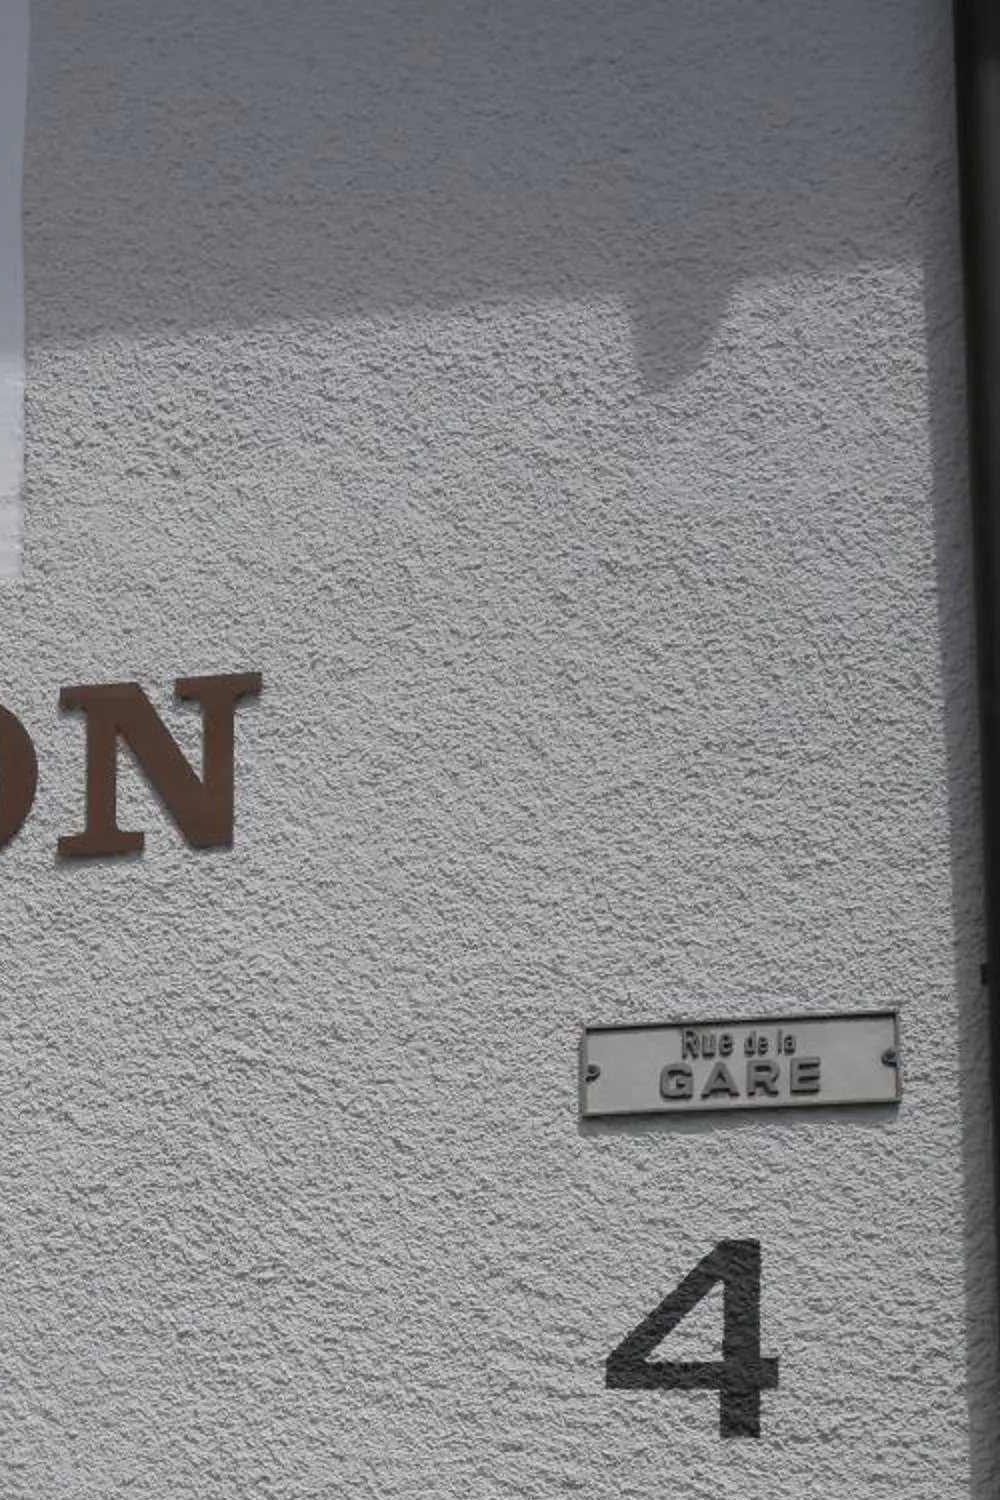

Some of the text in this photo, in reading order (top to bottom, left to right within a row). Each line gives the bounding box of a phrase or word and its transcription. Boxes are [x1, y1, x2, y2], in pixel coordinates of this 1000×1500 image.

[681, 1028, 797, 1060] Rue de la
[659, 1057, 821, 1101] GARE
[606, 1238, 779, 1439] 4
